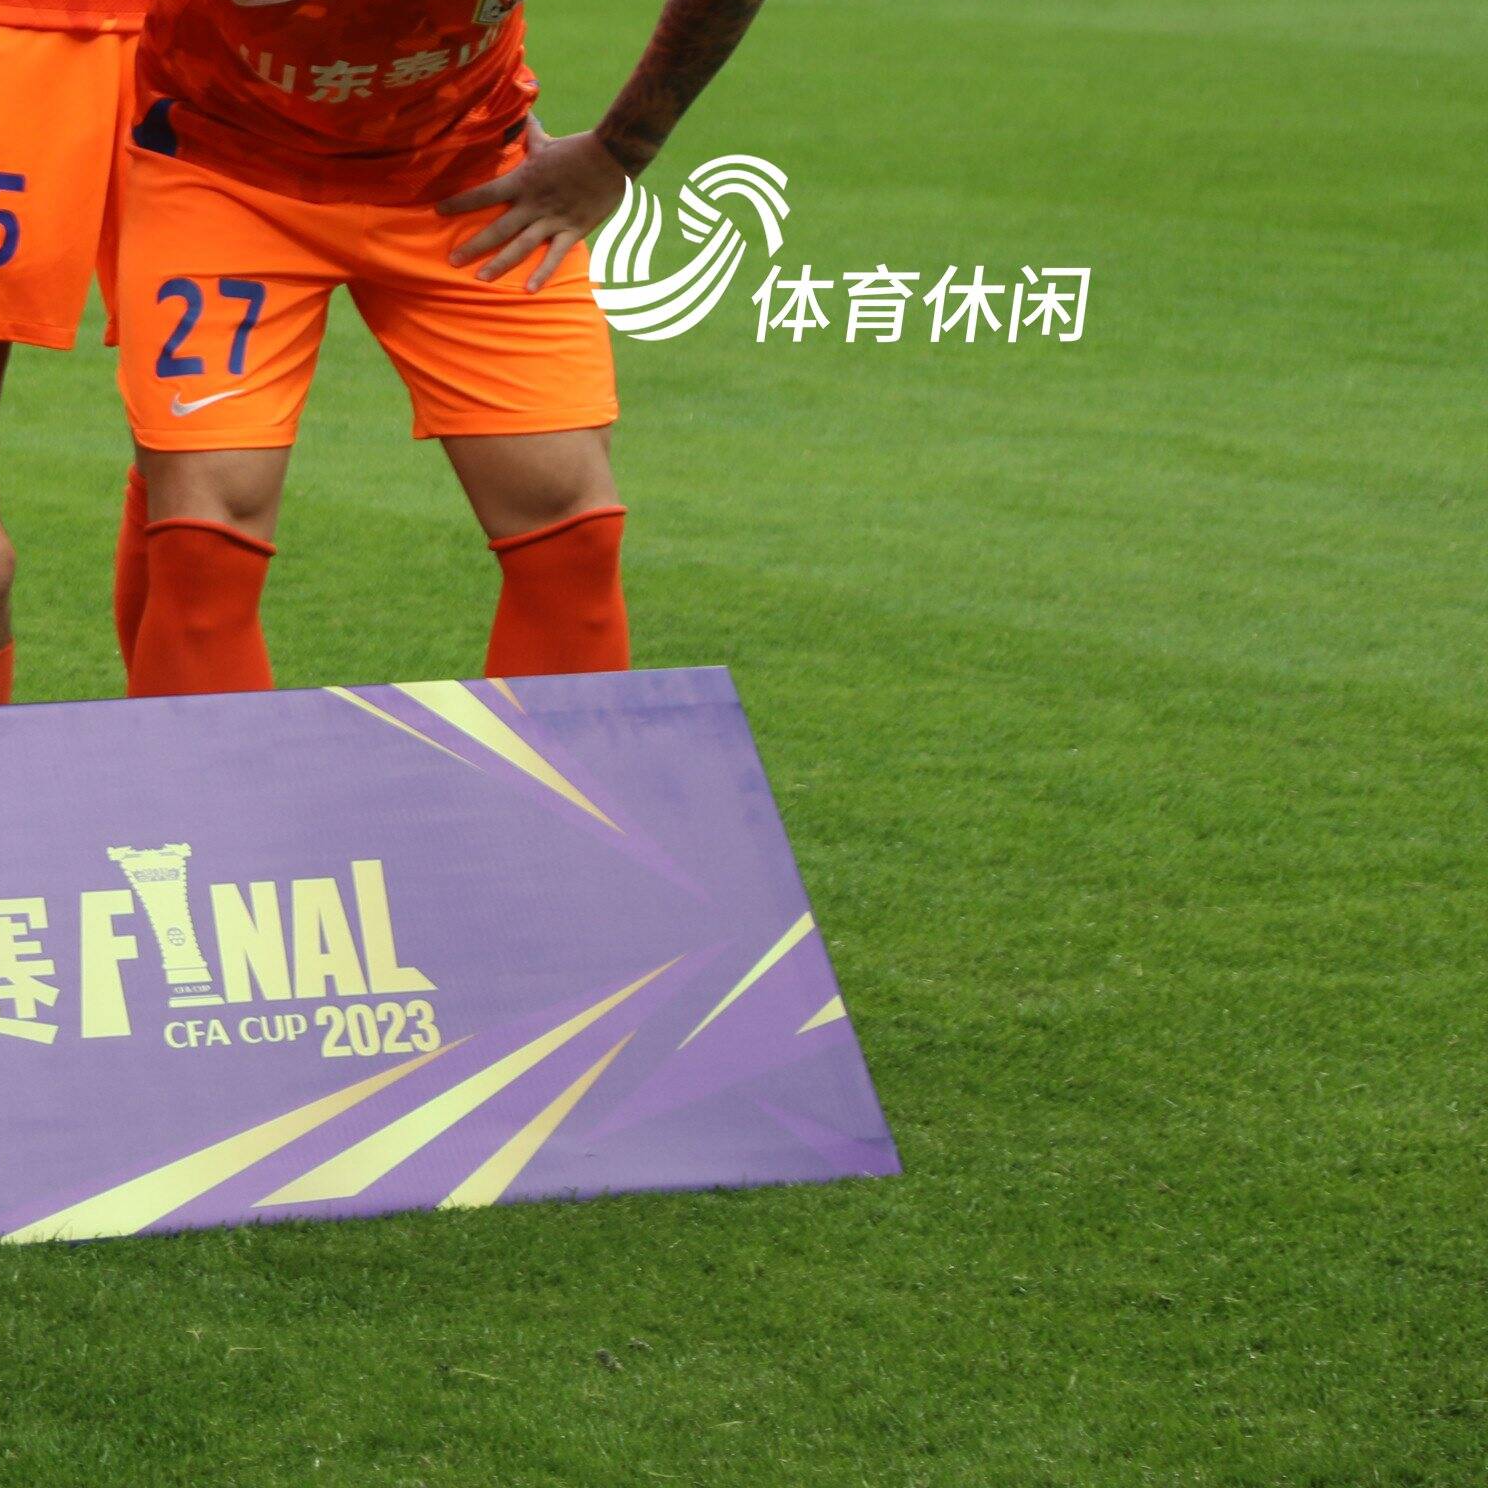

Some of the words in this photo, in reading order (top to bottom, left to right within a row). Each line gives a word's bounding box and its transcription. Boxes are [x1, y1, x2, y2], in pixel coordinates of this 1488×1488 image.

[155, 277, 266, 378] 27
[163, 1018, 232, 1050] CFA
[238, 1013, 309, 1044] CUP
[314, 999, 443, 1058] 2023
